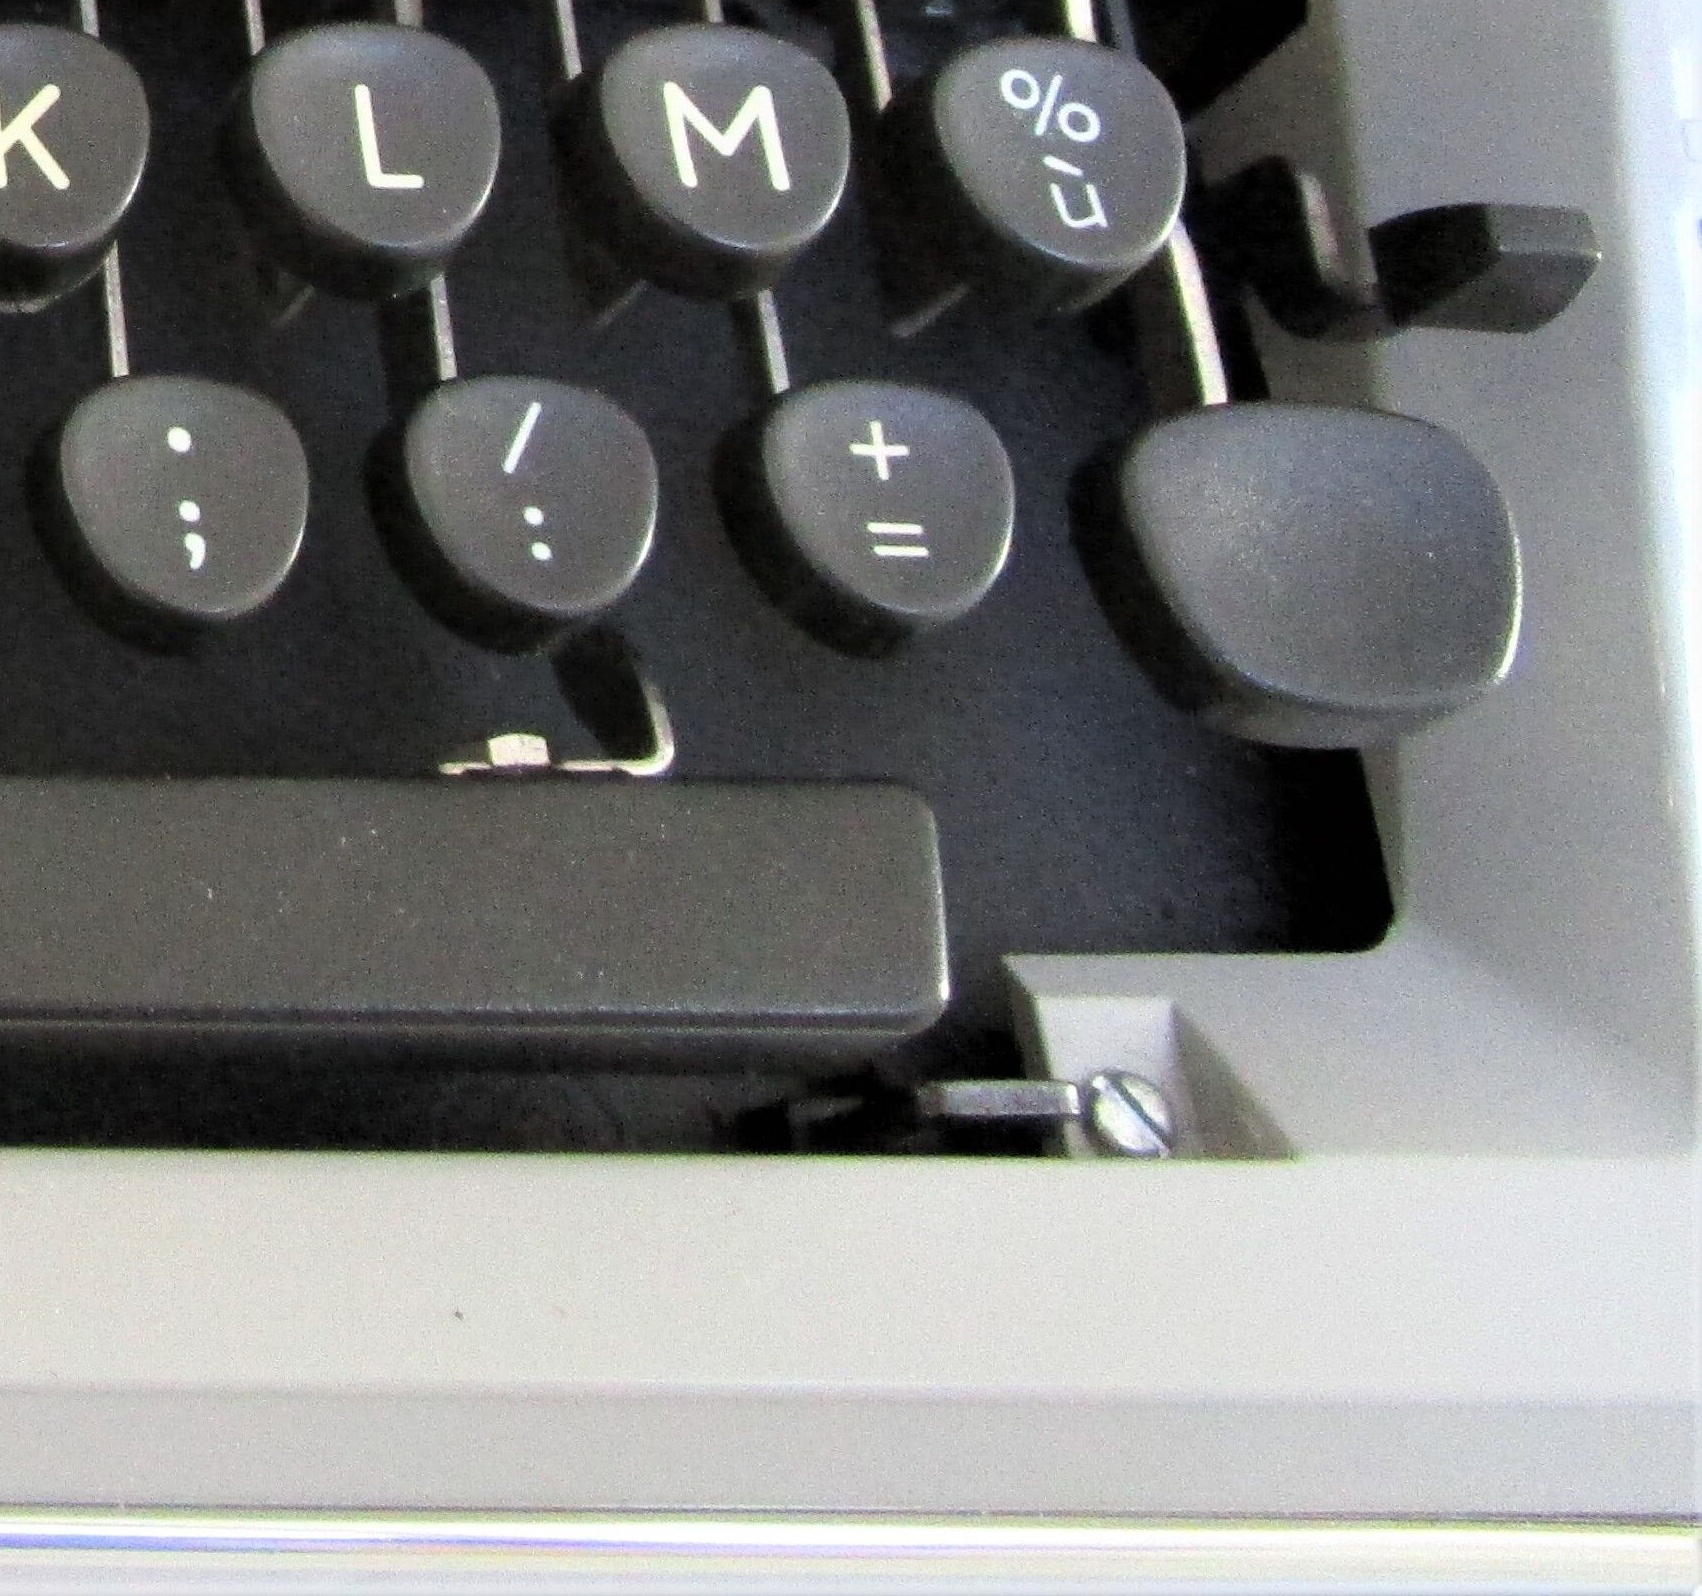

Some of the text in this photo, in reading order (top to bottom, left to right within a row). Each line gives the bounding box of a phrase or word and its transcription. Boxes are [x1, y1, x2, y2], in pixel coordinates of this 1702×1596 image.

[351, 82, 426, 191] L
[656, 78, 793, 194] M
[992, 62, 1103, 145] %
[1040, 153, 1110, 231] ù
